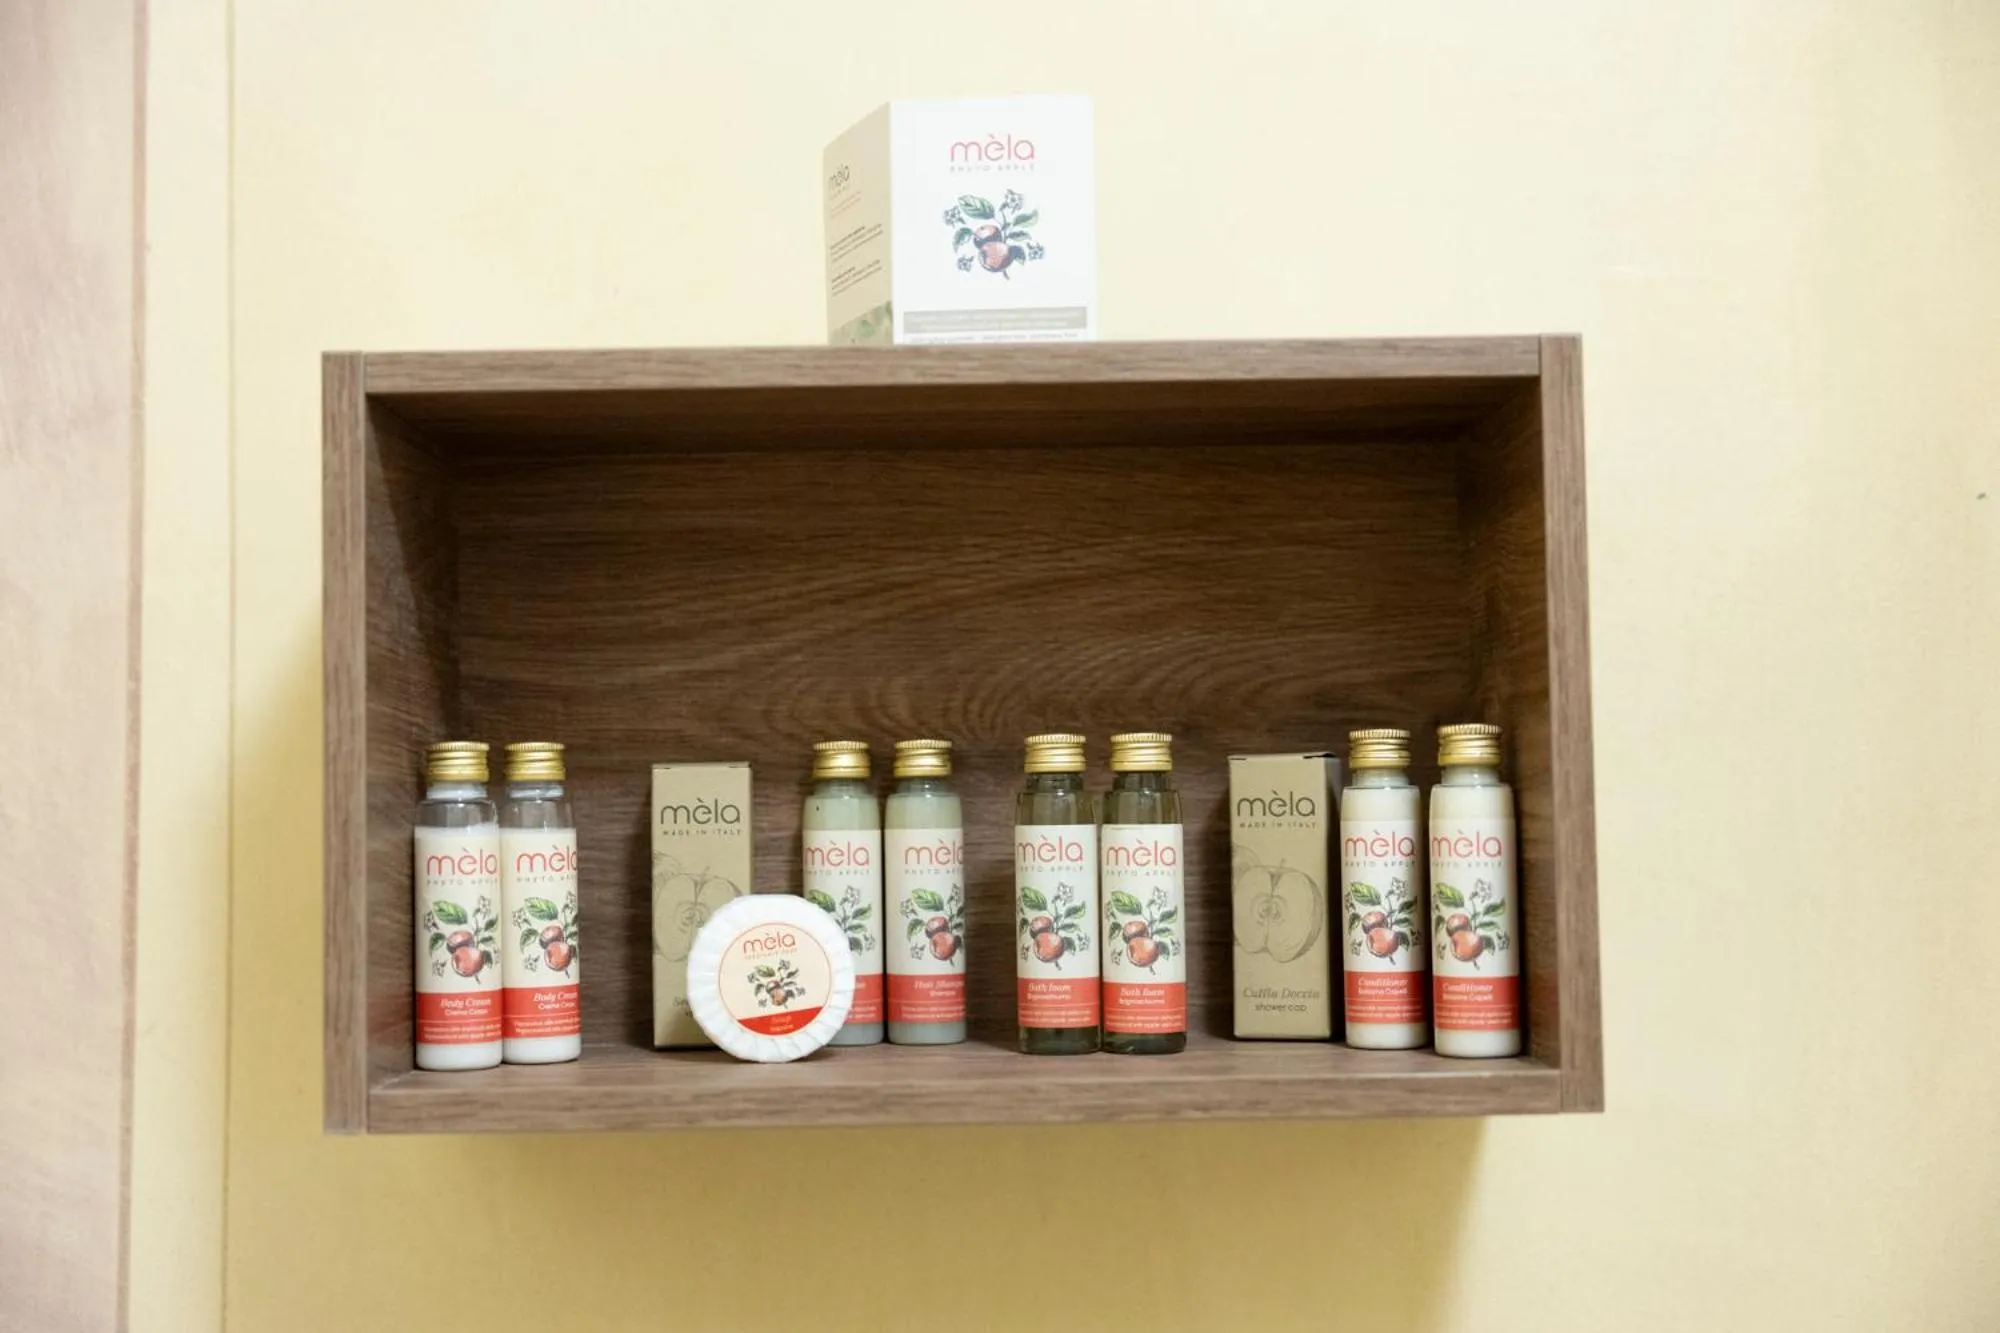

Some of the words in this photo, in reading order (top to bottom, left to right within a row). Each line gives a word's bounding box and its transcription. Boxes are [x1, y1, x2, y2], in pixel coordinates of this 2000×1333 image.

[949, 133, 1036, 162] mèla
[660, 798, 741, 825] mèla
[1236, 789, 1316, 817] mèla
[712, 828, 741, 836] ITALY
[1344, 830, 1416, 858] mèla
[1432, 829, 1502, 858] mèla
[427, 847, 498, 876] mèla
[805, 839, 870, 867] mèla
[1017, 834, 1084, 863] mèla
[1105, 839, 1177, 867] mèla
[742, 932, 797, 955] mèla
[1243, 987, 1278, 999] Cuffia
[1255, 1003, 1287, 1012] shower
